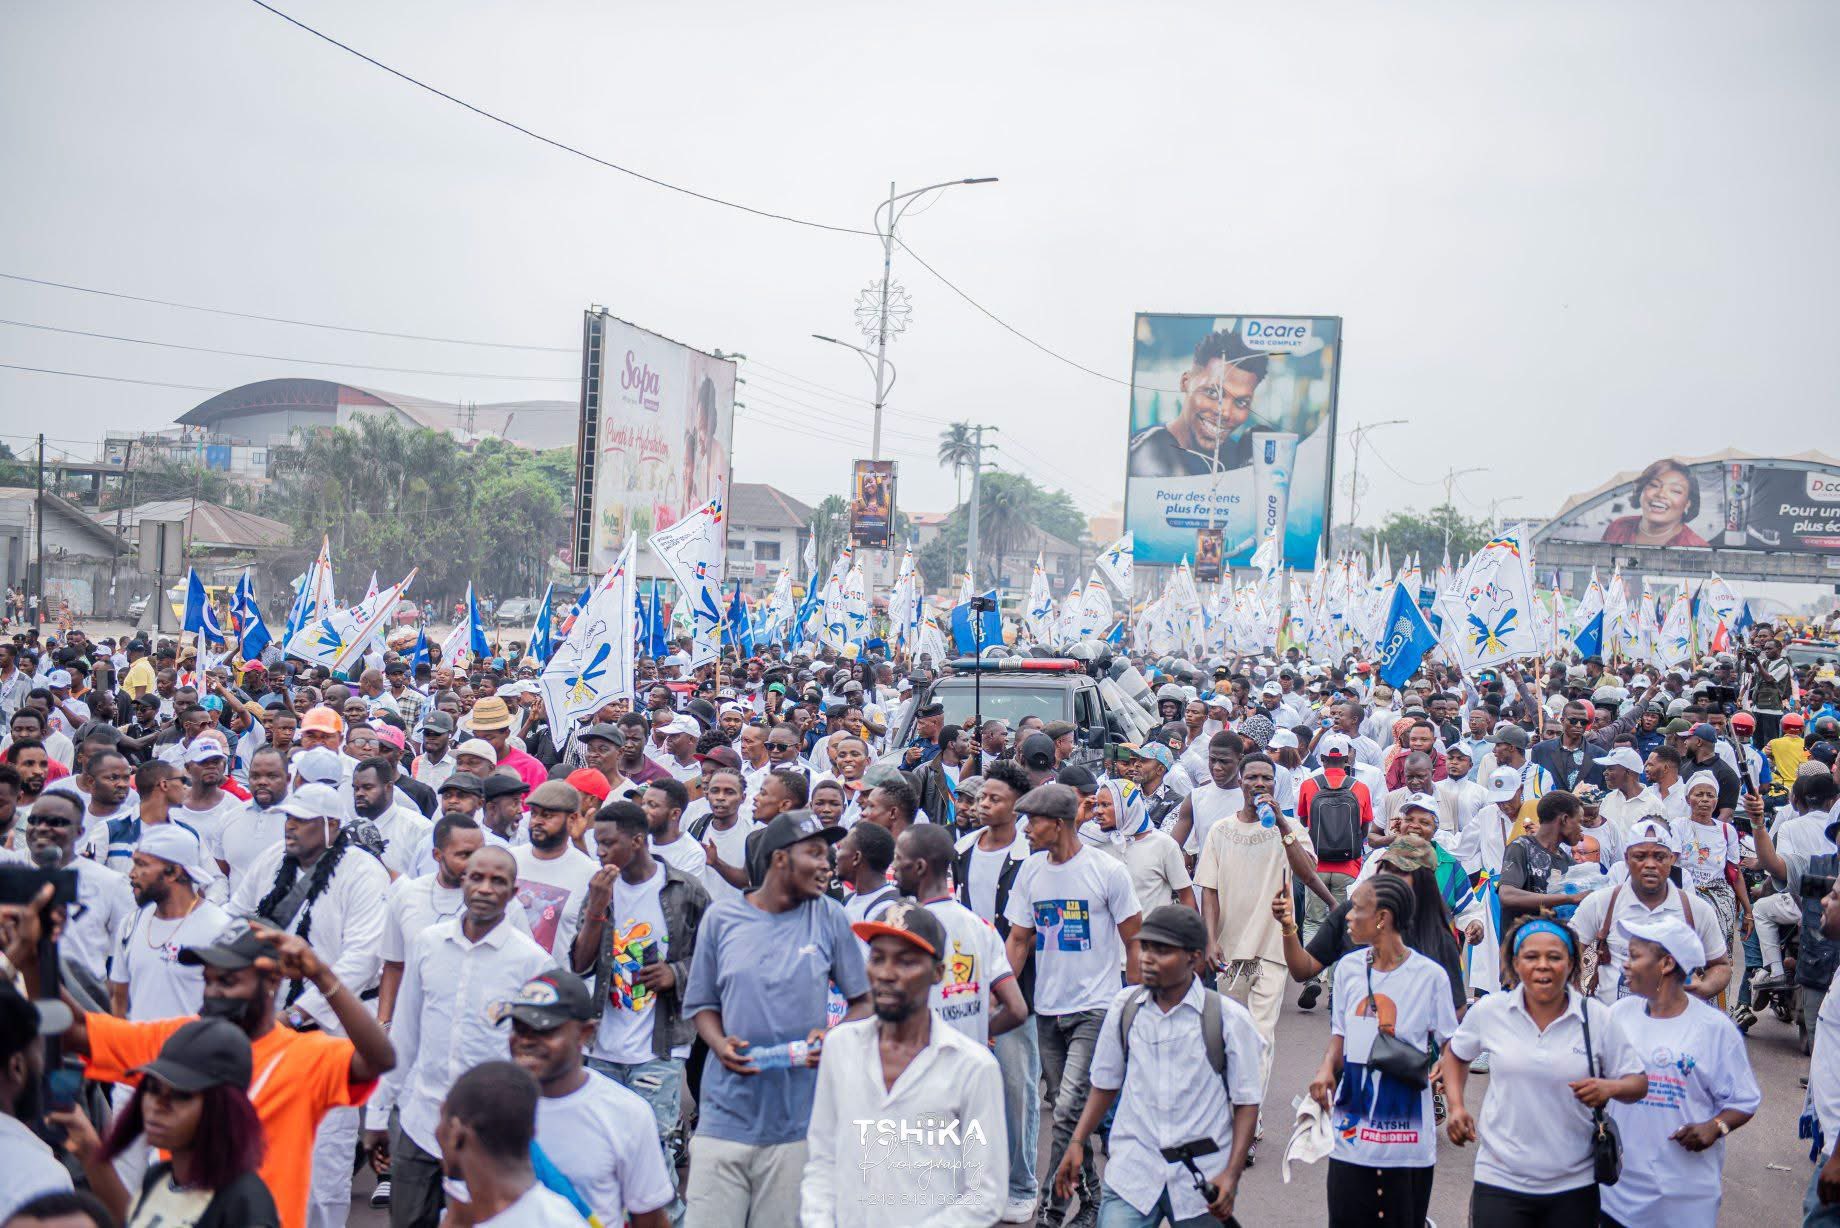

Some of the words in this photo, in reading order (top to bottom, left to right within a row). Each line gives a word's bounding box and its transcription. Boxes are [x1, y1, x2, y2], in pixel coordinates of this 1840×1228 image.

[1247, 320, 1306, 338] D.care
[621, 350, 660, 404] Sopa
[1156, 490, 1183, 501] Pour
[1185, 491, 1205, 502] des
[1166, 503, 1191, 515] plus
[1779, 503, 1817, 517] Pour
[1793, 520, 1824, 534] plus
[1370, 1119, 1410, 1130] FATSHI
